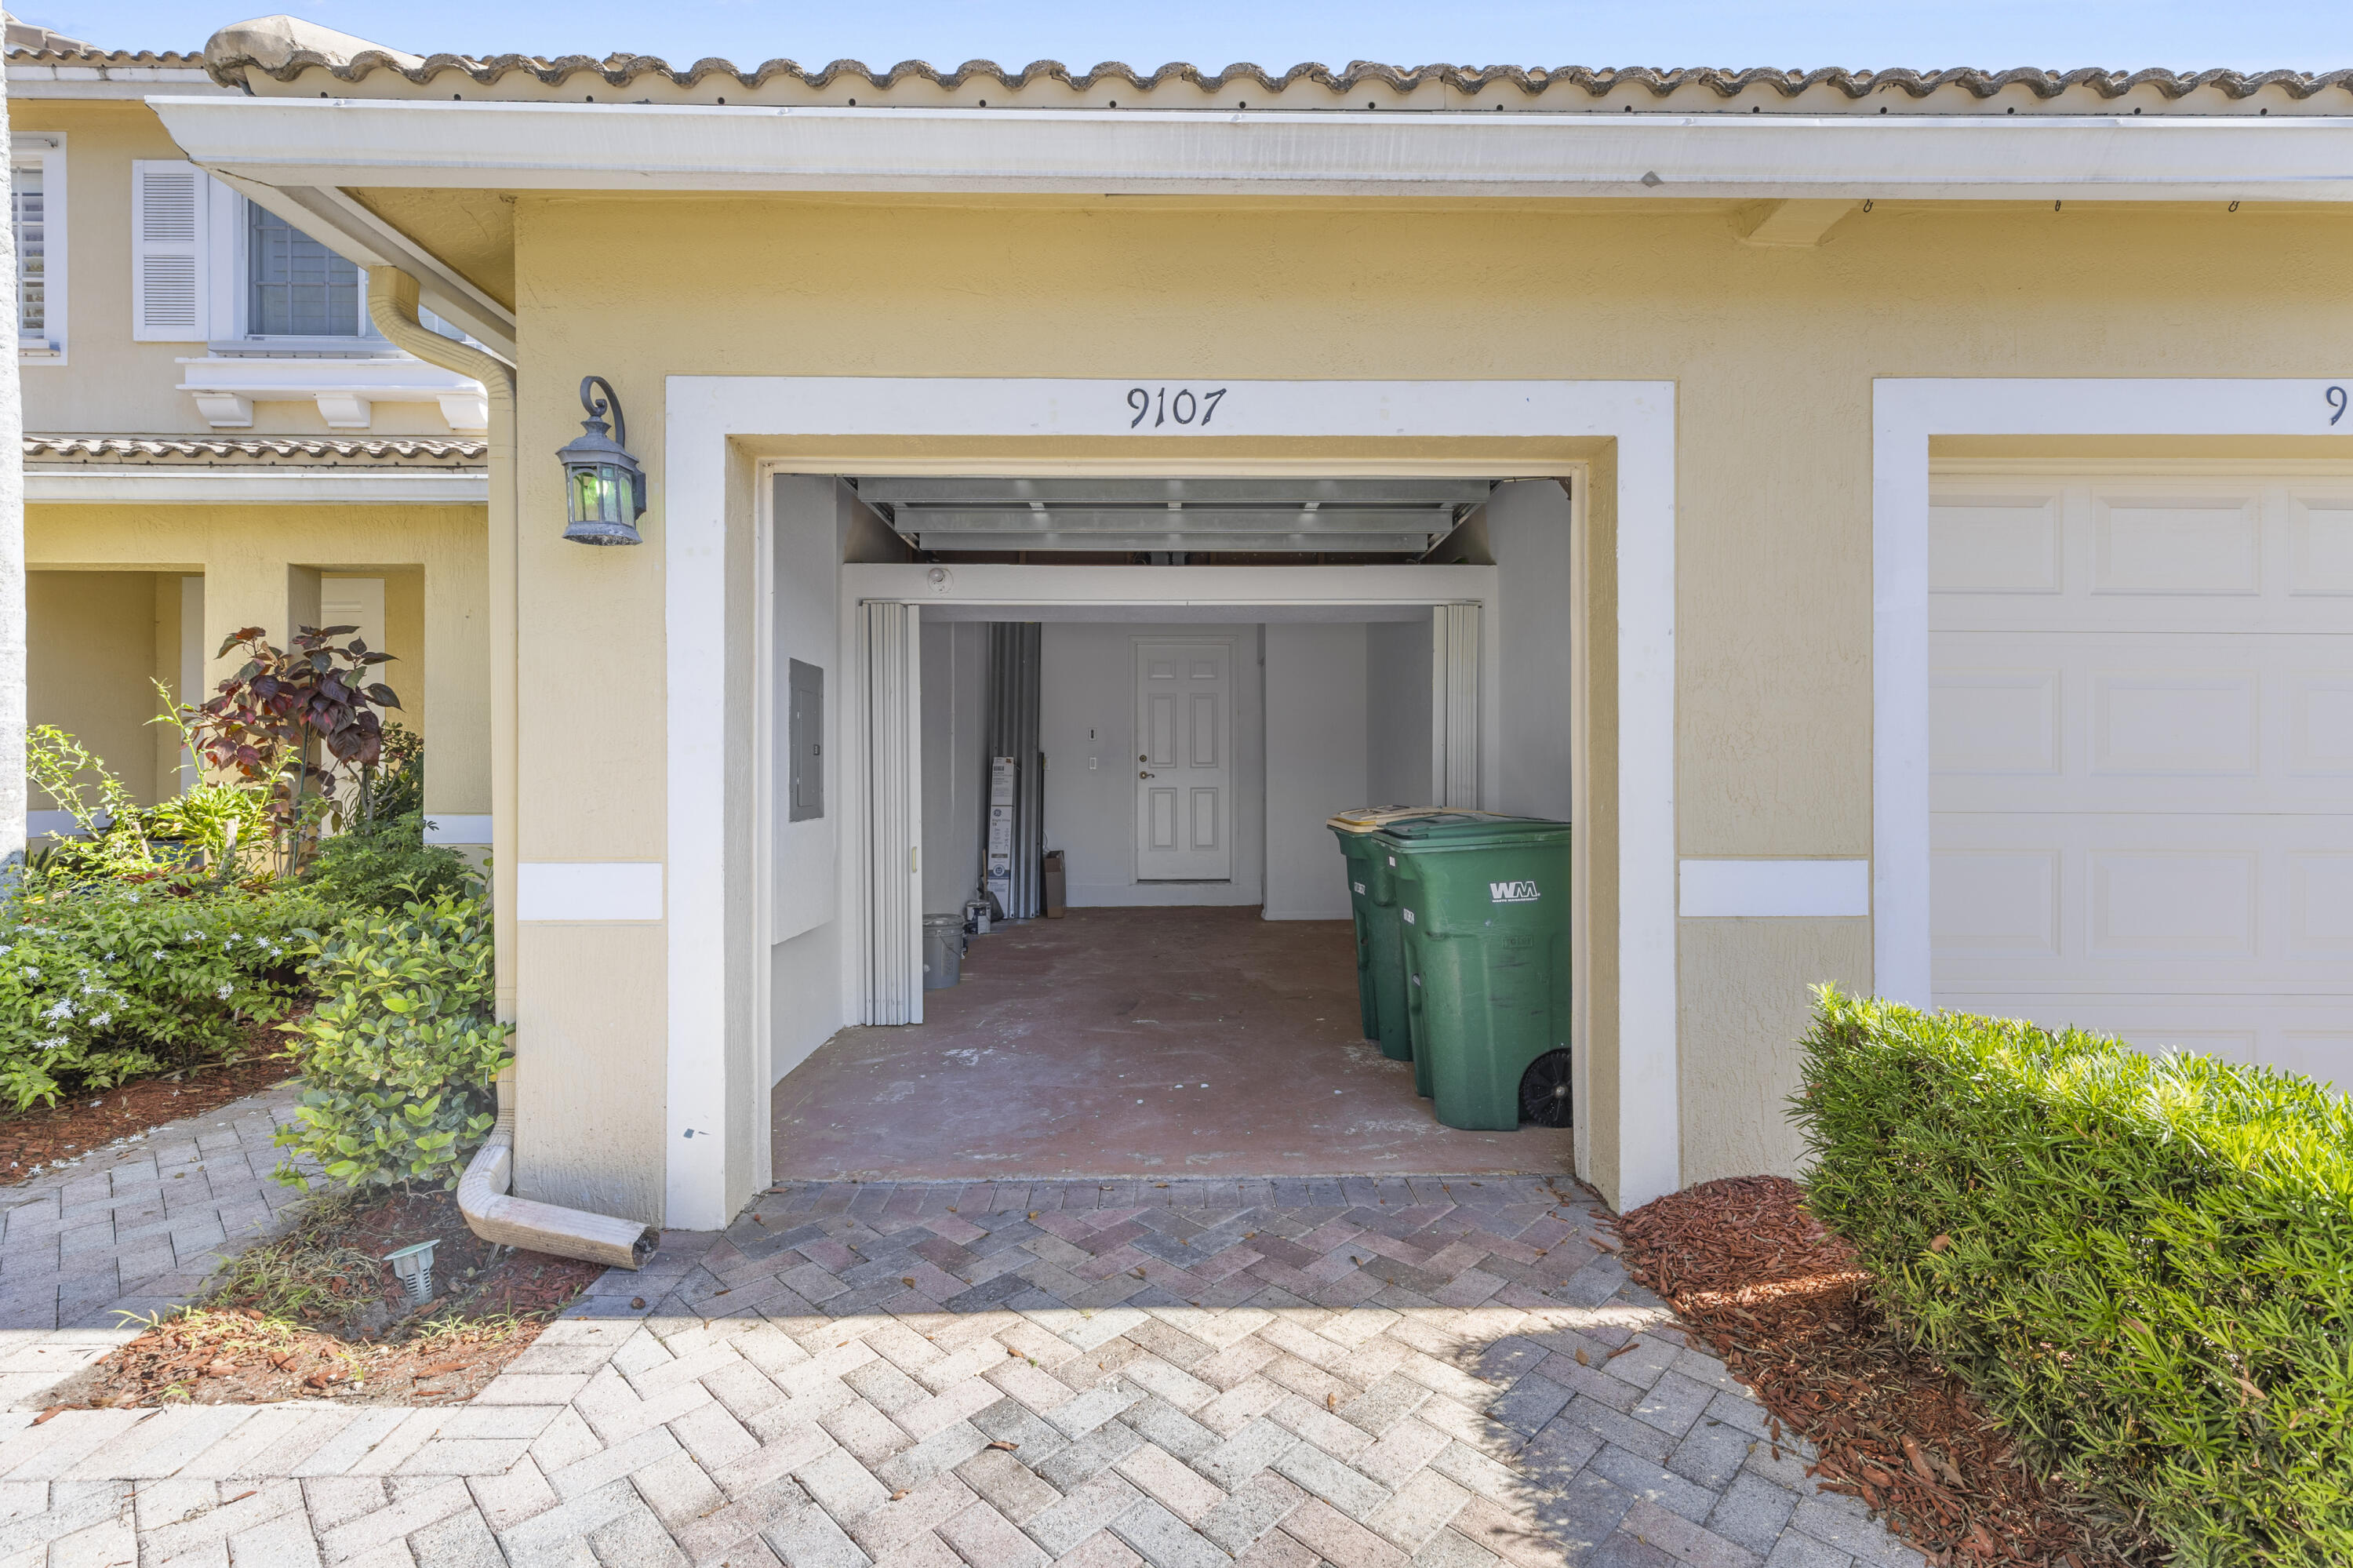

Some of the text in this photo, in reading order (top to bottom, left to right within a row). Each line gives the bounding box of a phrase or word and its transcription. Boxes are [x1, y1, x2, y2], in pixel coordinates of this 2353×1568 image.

[1127, 387, 1227, 428] 9107
[2326, 386, 2348, 426] 9
[1489, 881, 1538, 899] WM
